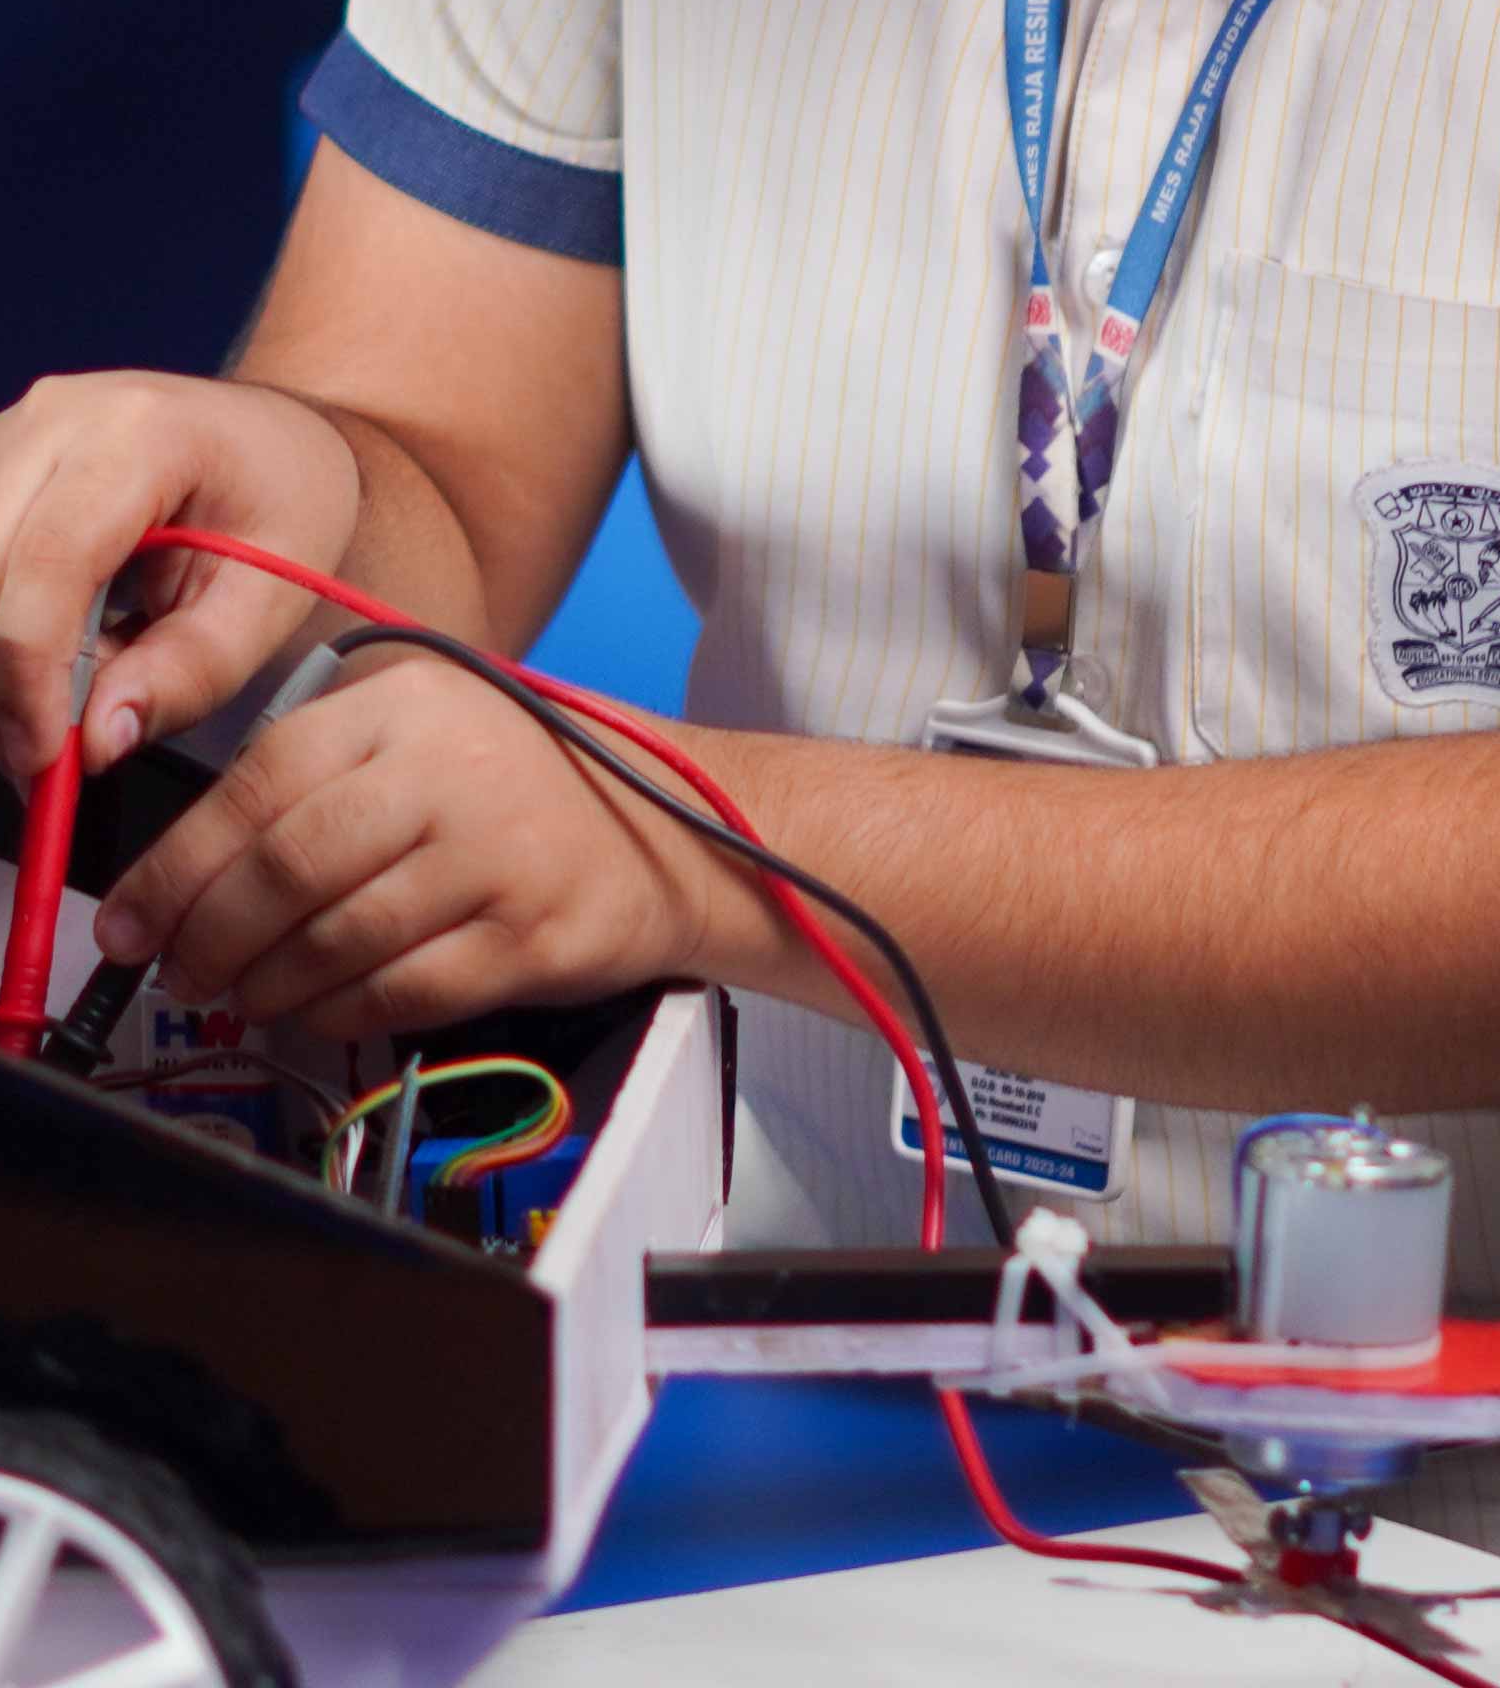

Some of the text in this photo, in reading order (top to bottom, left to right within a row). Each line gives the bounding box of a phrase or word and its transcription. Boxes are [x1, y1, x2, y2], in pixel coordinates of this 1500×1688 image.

[1026, 71, 1044, 137] RAJA
[1027, 145, 1040, 198] MES
[1151, 170, 1183, 224] MES
[1173, 103, 1208, 167] RAJA
[987, 1144, 1021, 1168] CARD
[1024, 1155, 1076, 1180] 2023-24
